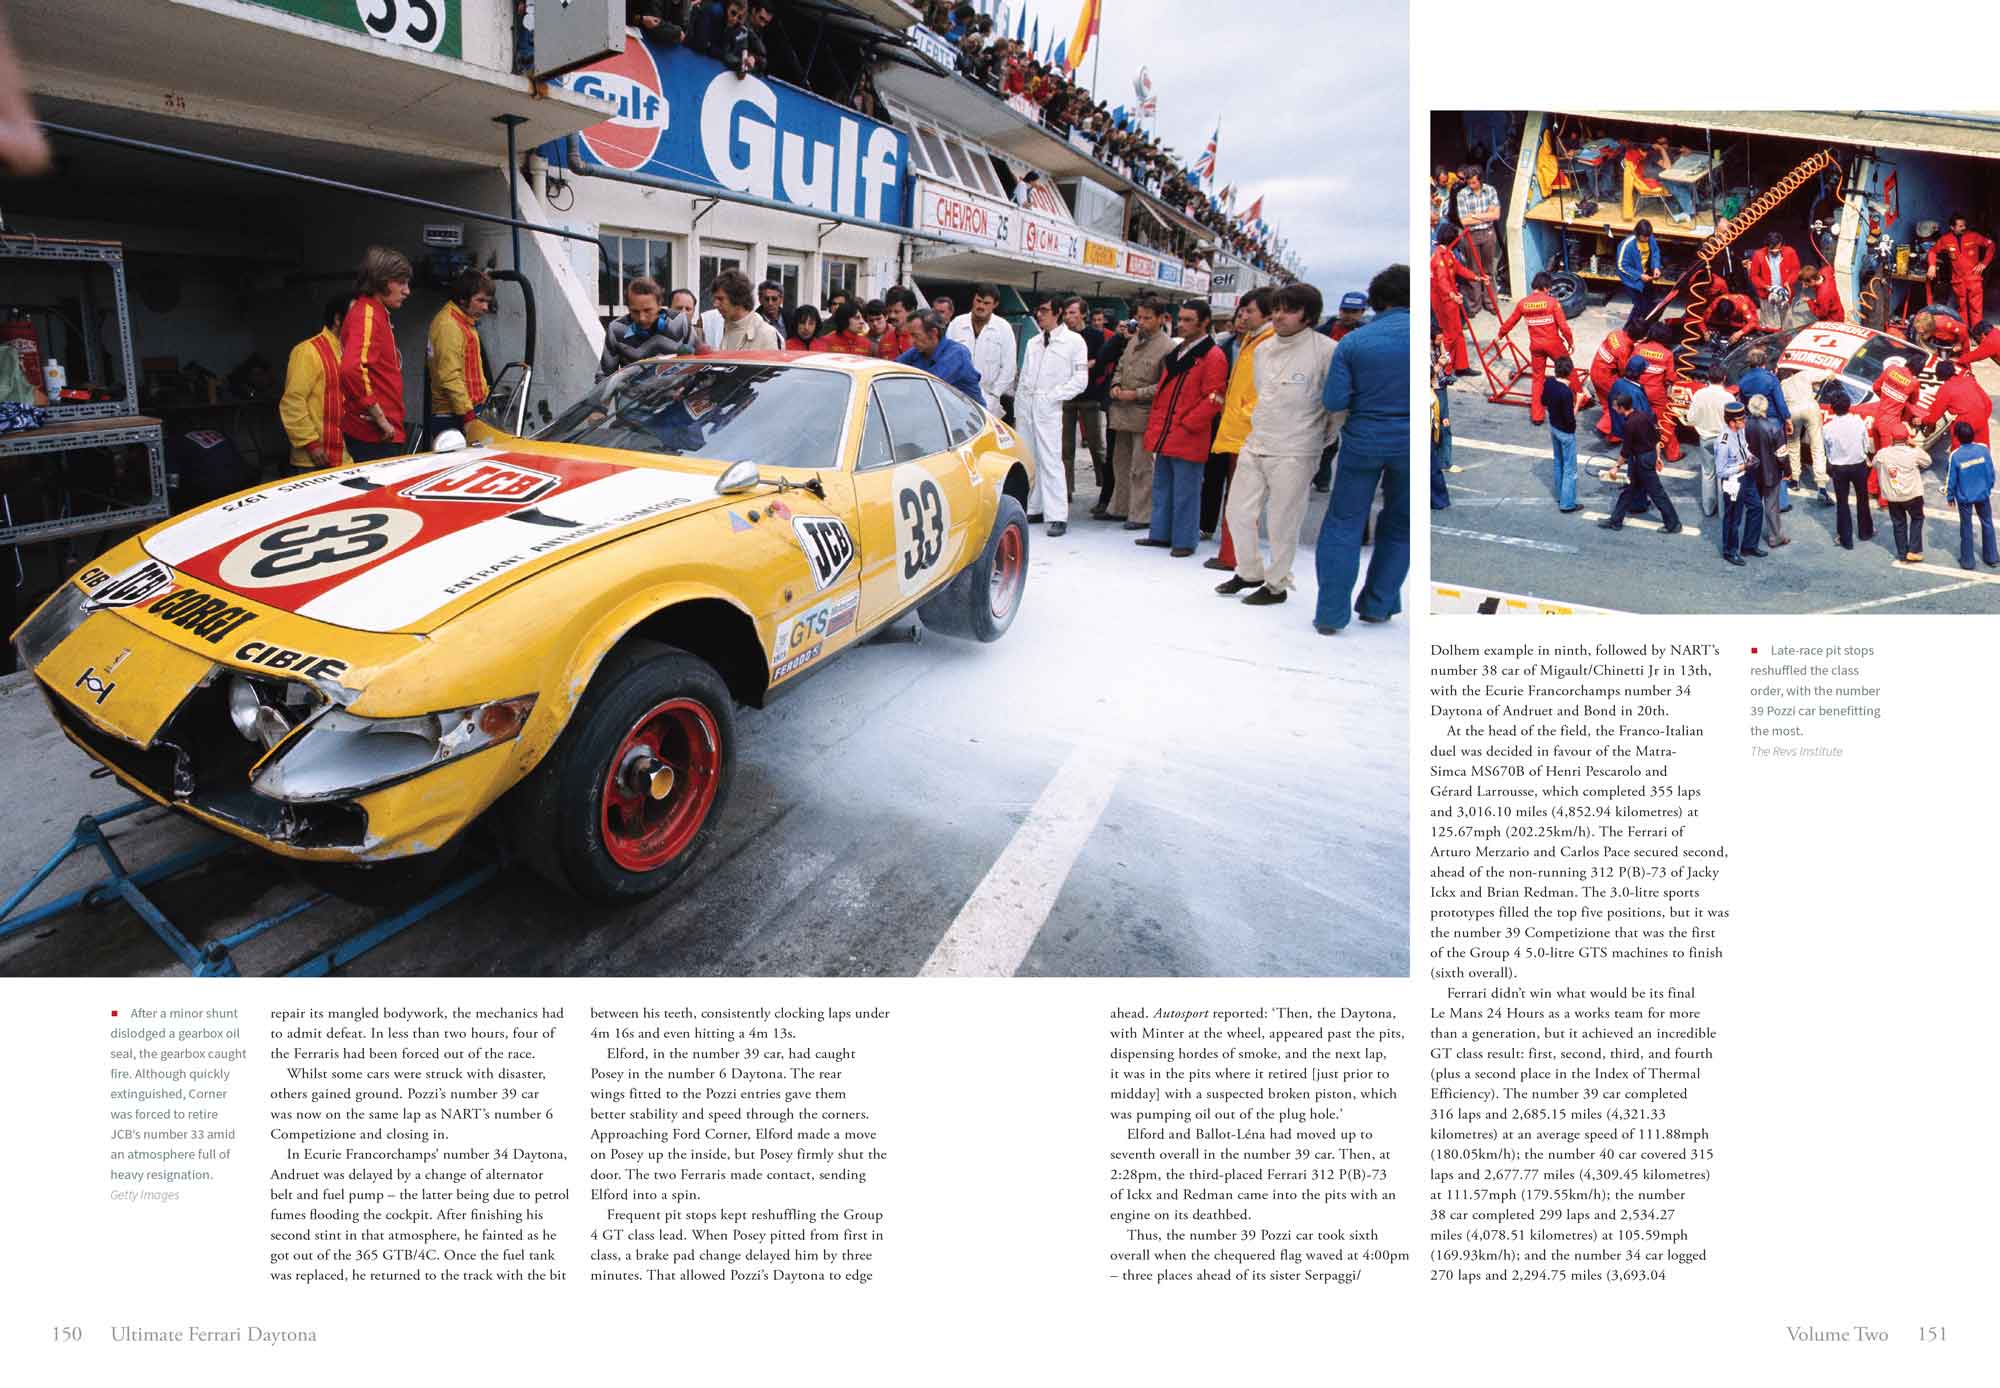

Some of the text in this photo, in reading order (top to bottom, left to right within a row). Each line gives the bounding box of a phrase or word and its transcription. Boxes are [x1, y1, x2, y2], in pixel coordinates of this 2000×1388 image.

[700, 70, 899, 225] Gulf
[936, 197, 1009, 241] CHEVRON 25
[1214, 272, 1235, 285] elf
[277, 473, 340, 494] HOURS
[423, 465, 543, 496] JCB
[221, 493, 269, 513] 1973
[899, 479, 944, 580] 33
[250, 513, 390, 579] 33
[802, 518, 850, 582] JCB
[91, 560, 168, 601] JCB
[443, 554, 526, 595] ENTRANT
[148, 588, 260, 644] CORGI
[789, 608, 829, 649] GTS
[1771, 644, 1875, 659] Late-race pit stops
[234, 642, 348, 680] CIBIE
[1750, 664, 1860, 676] reshuffled the class
[1430, 684, 1691, 700] with the Ecurie Francorchamps number 34
[1750, 685, 1881, 697] order, with the number
[1750, 704, 1881, 719] 39 Pozzi car benefitting
[1750, 725, 1804, 737] the most.
[1751, 743, 1844, 757] The Revs Institute
[1432, 825, 1686, 841] 125.67mph (202.25km/h). The Ferrari of
[130, 1007, 158, 1019] After
[169, 1008, 204, 1019] minor
[205, 1007, 239, 1019] shunt
[271, 1007, 564, 1023] repair its mangled bodywork, the mechanics had
[590, 1007, 890, 1023] between his teeth, consistently clocking laps under
[1110, 1007, 1396, 1023] ahead. Autosport reported: ‘Then, the Daytona,
[110, 1027, 166, 1042] dislodged
[178, 1027, 224, 1042] gearbox
[225, 1027, 240, 1039] oil
[110, 1047, 247, 1063] seal, the gearbox caught
[110, 1067, 231, 1082] fire. Although quickly
[110, 1087, 228, 1102] extinguished, Corner
[110, 1108, 219, 1120] was forced to retire
[111, 1127, 236, 1140] JCB's number 33 amid
[270, 1127, 449, 1144] Competizione and closing in.
[1127, 1127, 1373, 1144] Elford and Ballot-Léna had moved up to
[110, 1148, 231, 1162] an atmosphere full of
[110, 1169, 214, 1183] heavy resignation.
[110, 1189, 180, 1204] Getty Images
[591, 1188, 628, 1201] Elford
[633, 1189, 657, 1200] into
[671, 1190, 701, 1204] spin.
[607, 1208, 884, 1224] Frequent pit stops kept reshuffling the Group
[1109, 1208, 1252, 1224] engine on its deathbed.
[1430, 1268, 1666, 1285] 270 laps and 2,294.75 miles (3,693.04
[53, 1326, 83, 1342] 150
[111, 1325, 317, 1347] Ultimate Ferrari Daytona
[1786, 1325, 1889, 1345] Volume Two
[1919, 1326, 1945, 1342] 151
